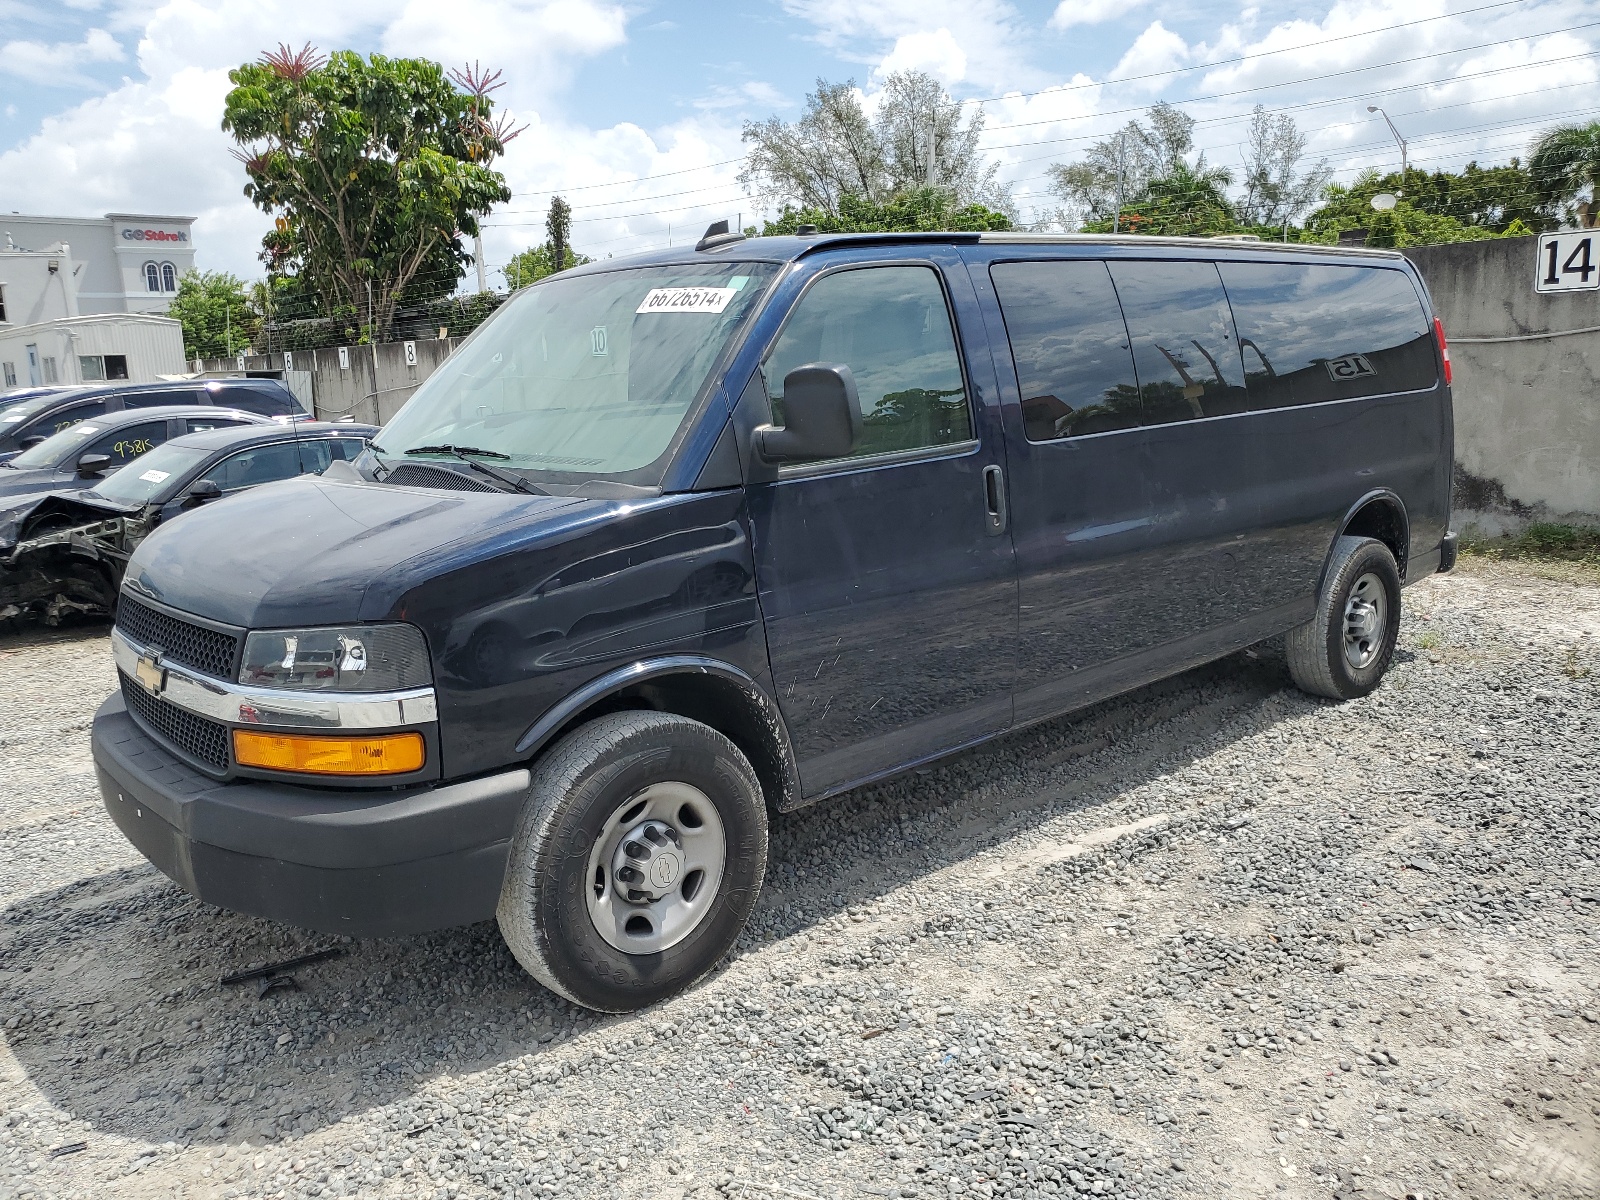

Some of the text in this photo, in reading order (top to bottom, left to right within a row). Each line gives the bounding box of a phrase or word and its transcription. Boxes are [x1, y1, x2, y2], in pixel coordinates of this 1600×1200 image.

[1543, 237, 1596, 285] 14
[592, 329, 606, 352] 10
[286, 354, 292, 370] 6
[340, 350, 346, 366] 7
[407, 344, 414, 362] 8
